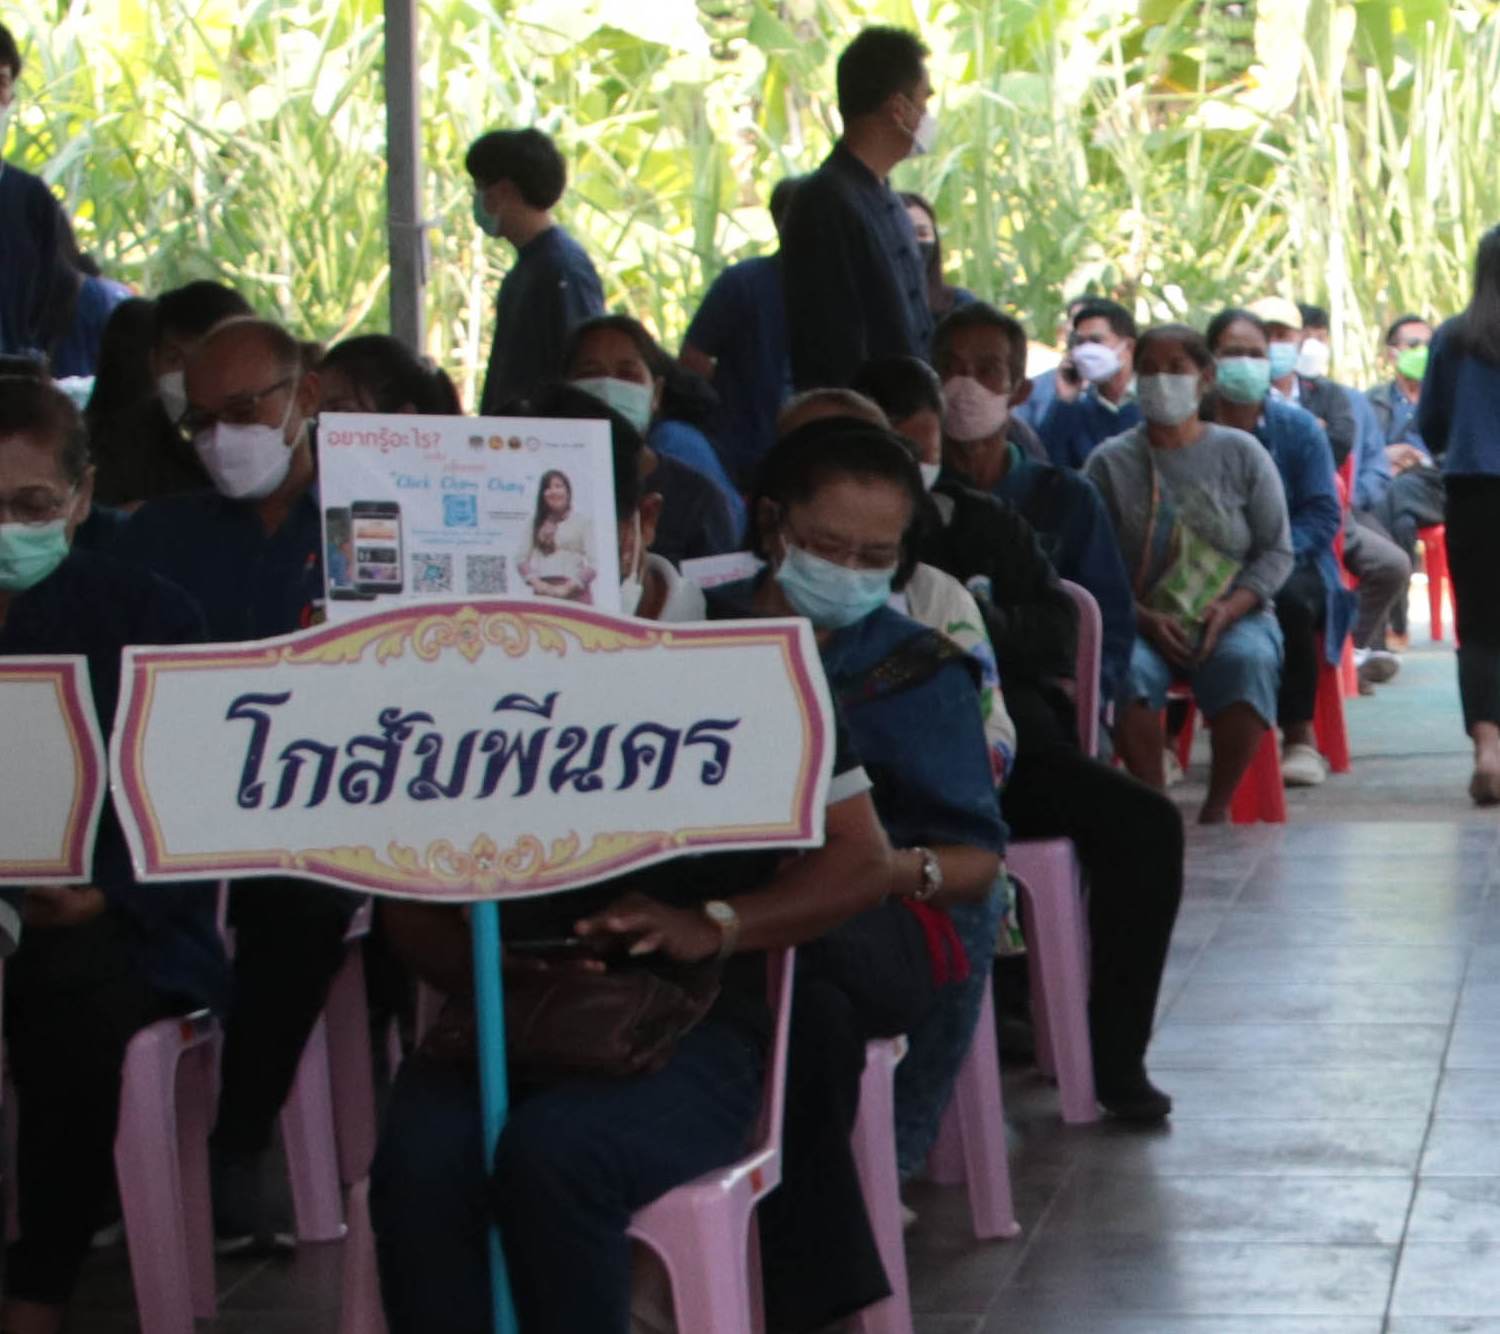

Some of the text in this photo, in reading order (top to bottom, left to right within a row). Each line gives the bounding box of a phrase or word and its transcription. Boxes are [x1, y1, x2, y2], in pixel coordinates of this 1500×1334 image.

[327, 427, 442, 454] อยากรู้อะไร?
[225, 690, 741, 811] โกสัมพีนคร
